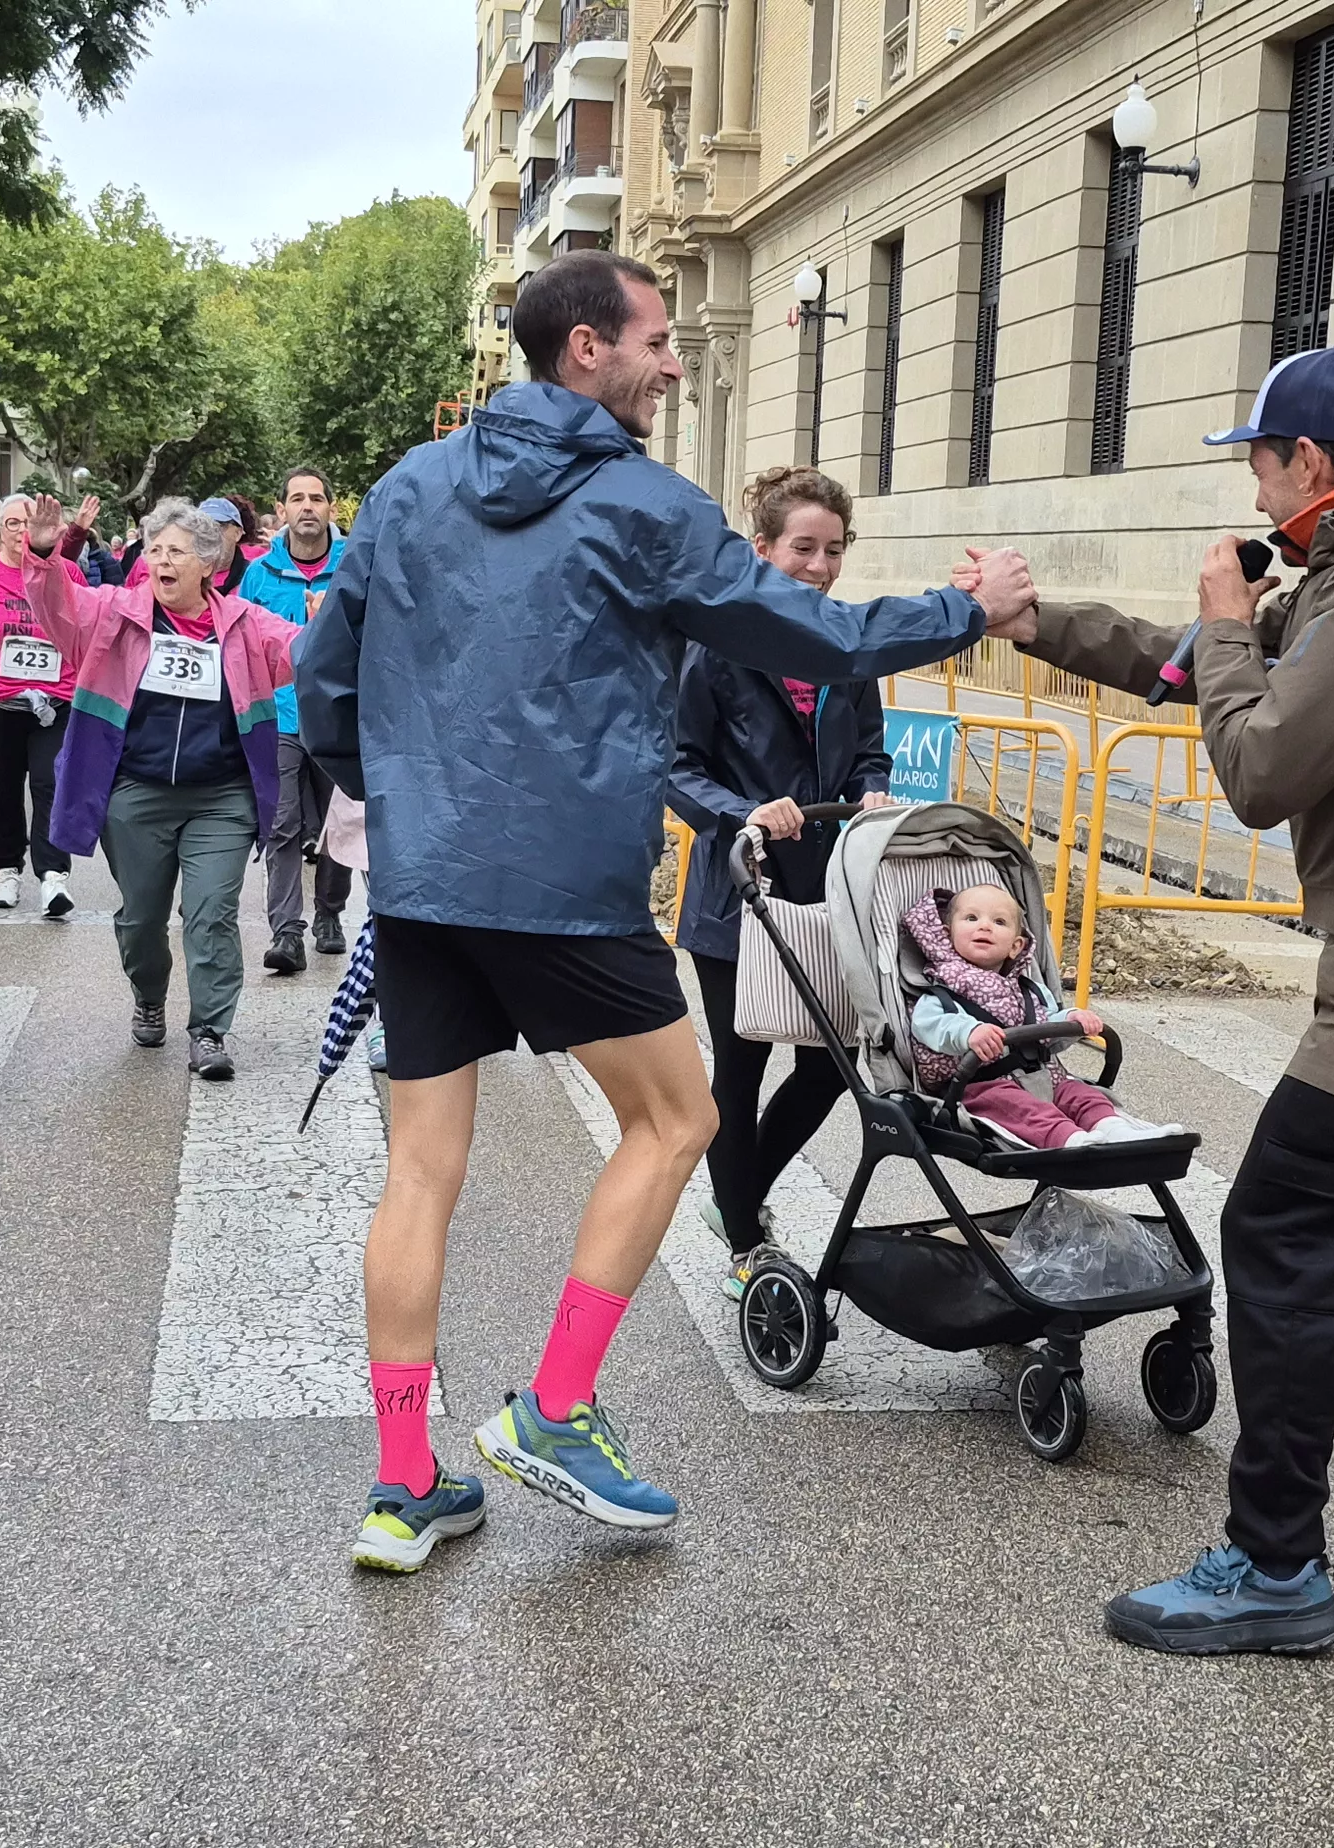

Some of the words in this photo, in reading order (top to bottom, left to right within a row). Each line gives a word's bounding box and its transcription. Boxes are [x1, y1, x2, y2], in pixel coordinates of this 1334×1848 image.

[12, 651, 49, 669] 423
[158, 657, 204, 681] 339
[883, 721, 947, 770] AN
[889, 768, 939, 790] ILIARIOS
[375, 1382, 429, 1416] STAY
[492, 1447, 587, 1507] SCARPA
